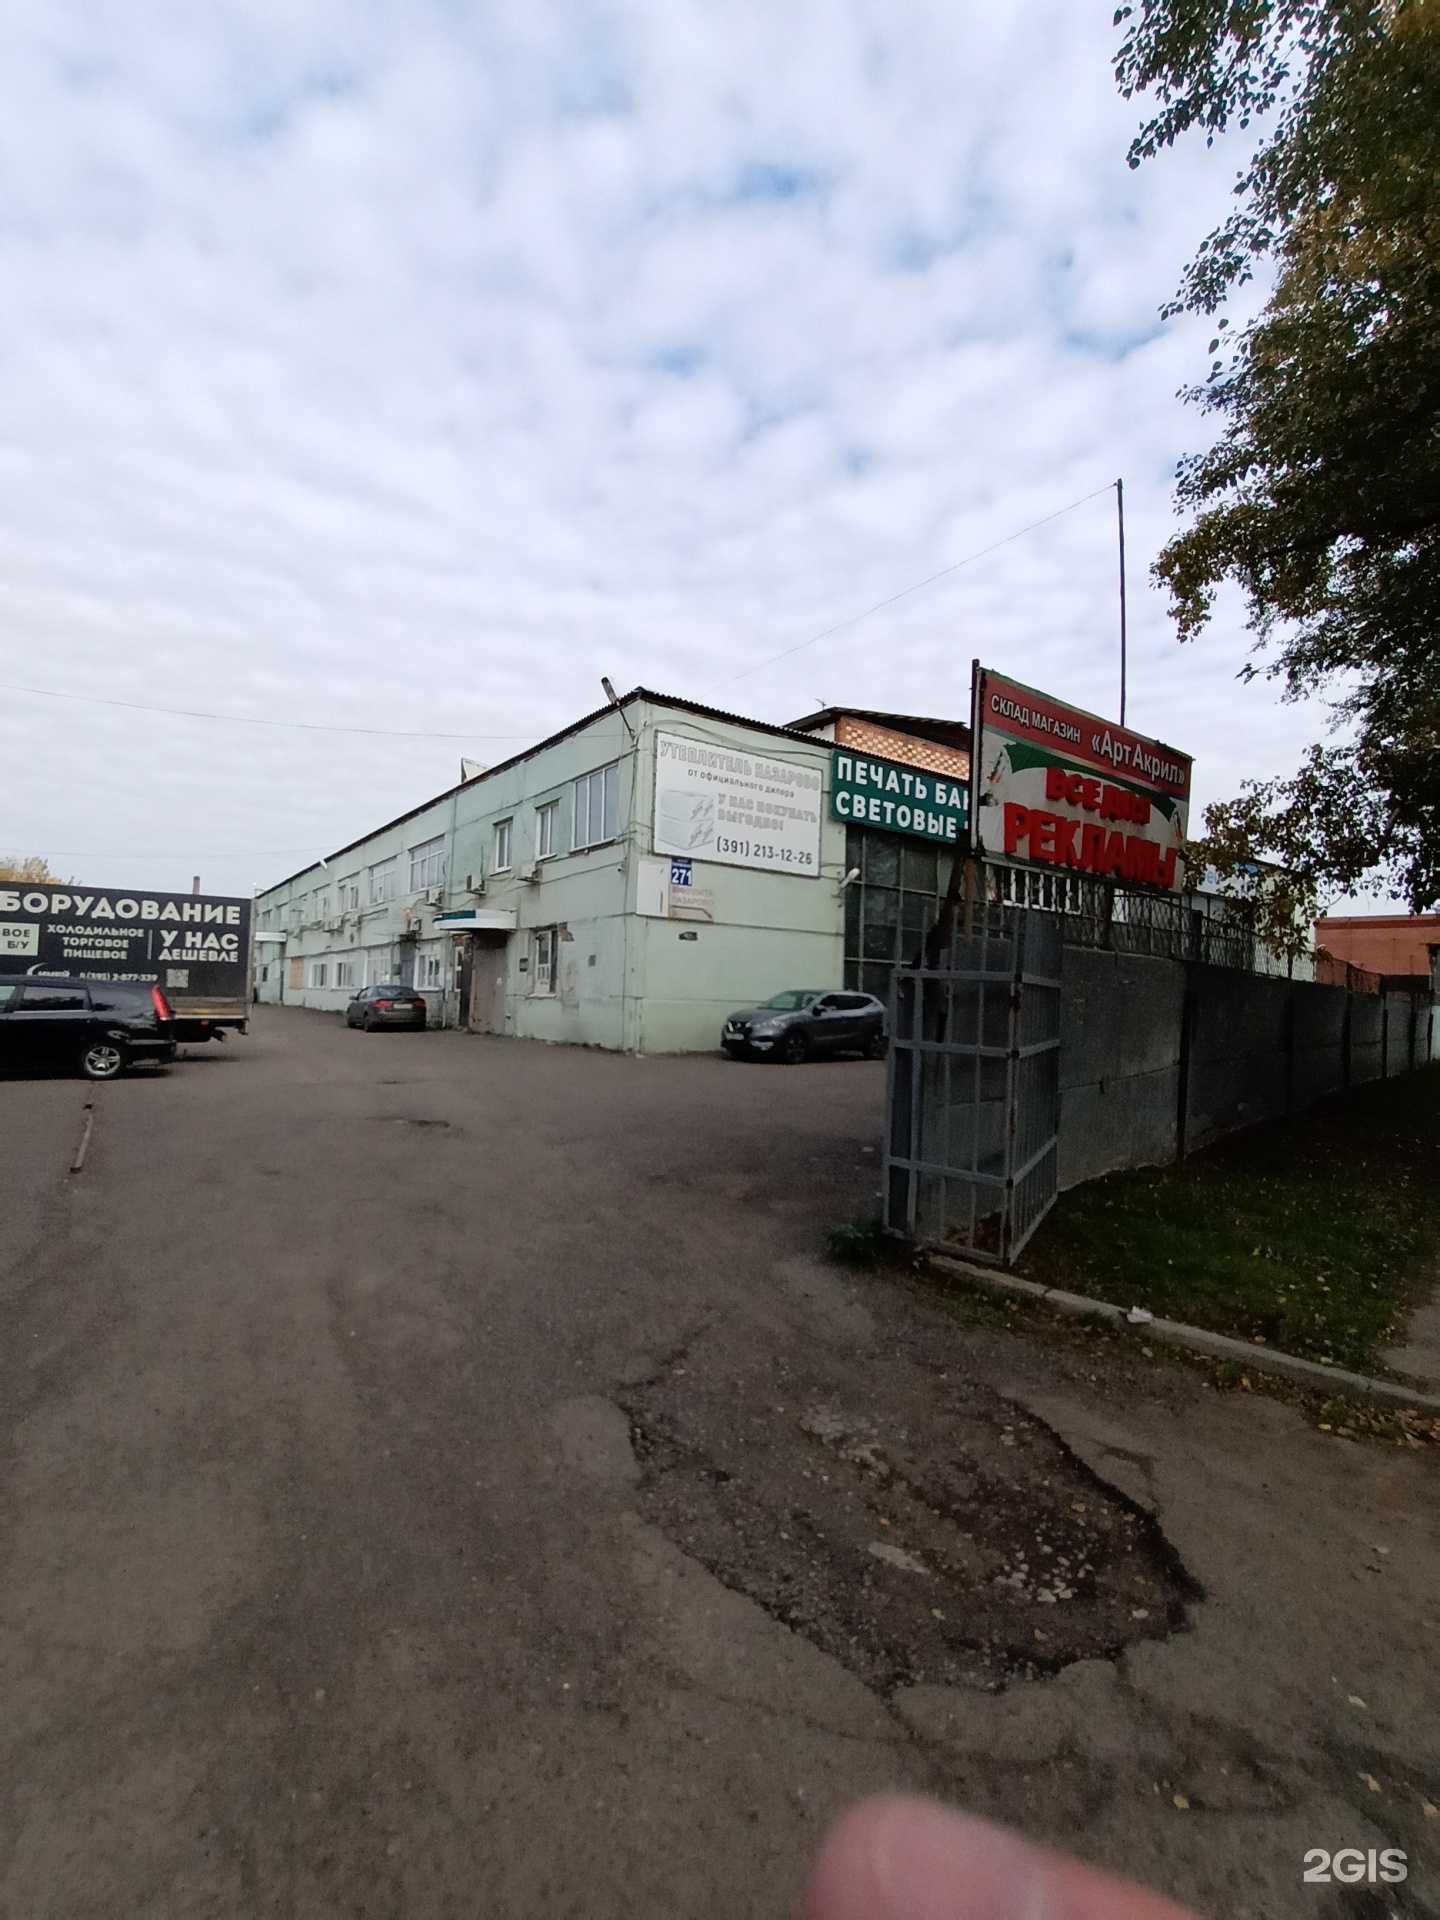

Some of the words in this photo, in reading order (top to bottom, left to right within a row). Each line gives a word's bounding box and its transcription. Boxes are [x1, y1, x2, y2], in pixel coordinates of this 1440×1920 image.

[991, 694, 1030, 726] СКЛАД
[1032, 711, 1081, 744] МАГАЗИН
[838, 756, 927, 799] ПЕЧАТЬ
[835, 791, 957, 839] СВЕТОВЫЕ
[717, 836, 749, 857] (391)
[754, 844, 813, 865] 213-12-26
[1003, 801, 1178, 889] РЕКЛАМЫ
[47, 924, 144, 937] ХОЛОДИЛЬНОЕ
[160, 929, 178, 947] У
[185, 931, 239, 950] НАС
[7, 940, 29, 949] Б/У
[62, 936, 129, 948] ТОРГОВОЕ
[63, 948, 128, 960] ПИЩЕВОЕ
[158, 948, 239, 962] ДЕШЕВЛЕ
